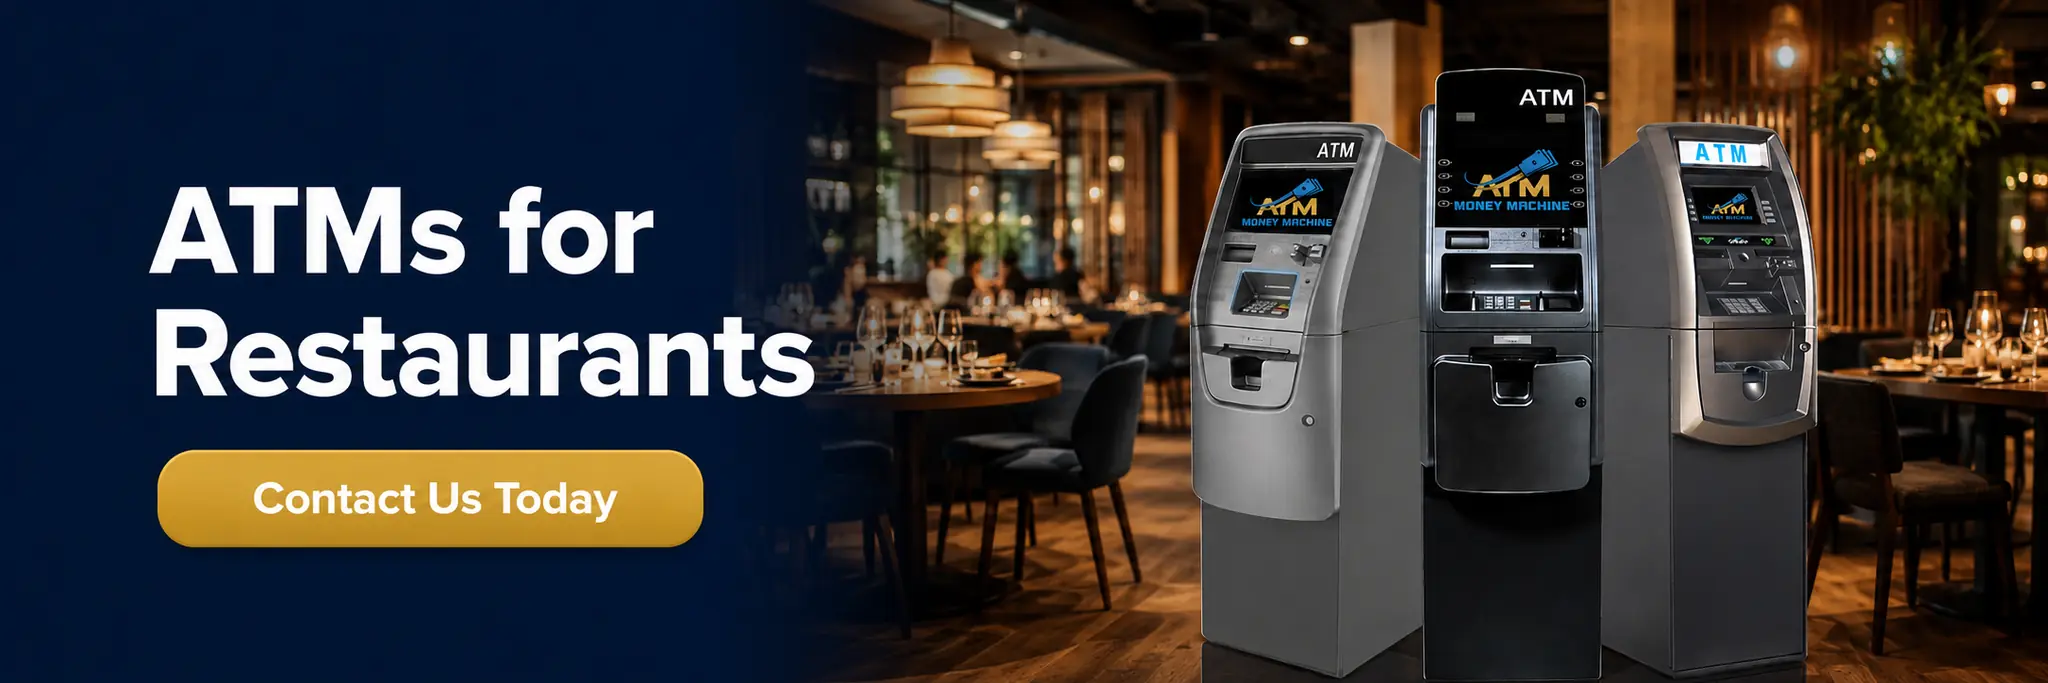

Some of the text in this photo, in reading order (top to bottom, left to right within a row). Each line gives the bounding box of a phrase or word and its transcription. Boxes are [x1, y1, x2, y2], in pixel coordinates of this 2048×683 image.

[1519, 88, 1574, 106] ATM
[1316, 142, 1355, 158] ATM
[1695, 142, 1747, 164] ATM
[1472, 173, 1551, 198] ATM
[1256, 197, 1318, 216] ATM
[1454, 200, 1570, 211] MONEY MACHINE
[1711, 203, 1745, 215] ATM
[1241, 218, 1333, 227] MONEY MACHINE
